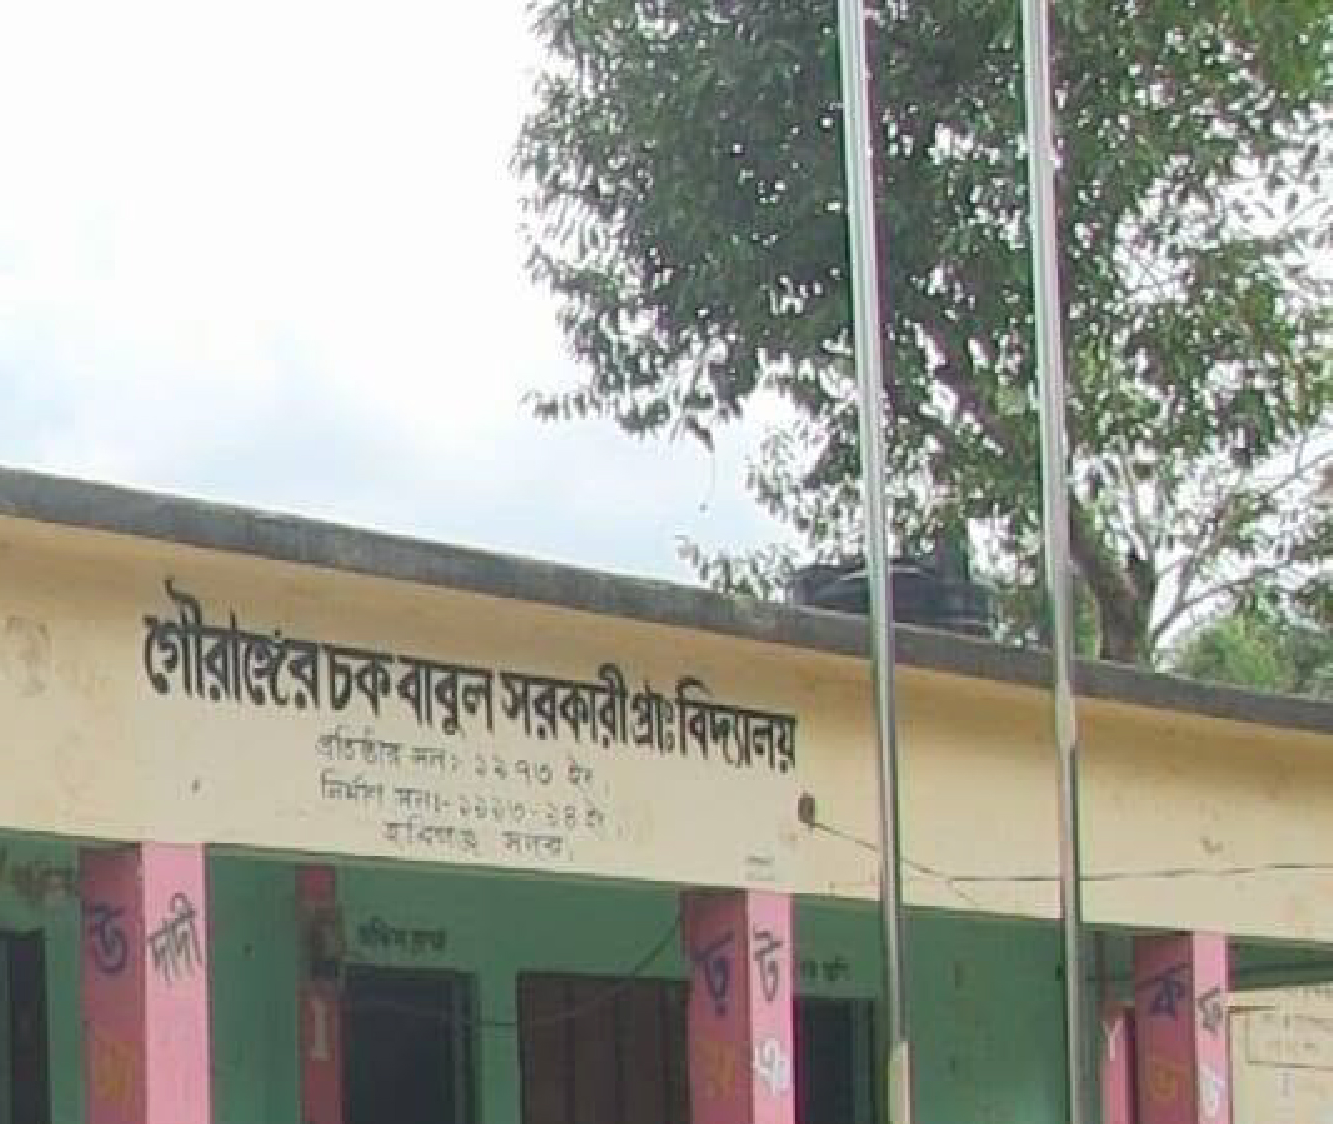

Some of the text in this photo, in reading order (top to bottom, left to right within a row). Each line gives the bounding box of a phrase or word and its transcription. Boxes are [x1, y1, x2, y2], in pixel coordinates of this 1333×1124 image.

[323, 644, 391, 715] চক
[395, 654, 495, 737] বাবুল
[500, 663, 629, 750] সরকারী
